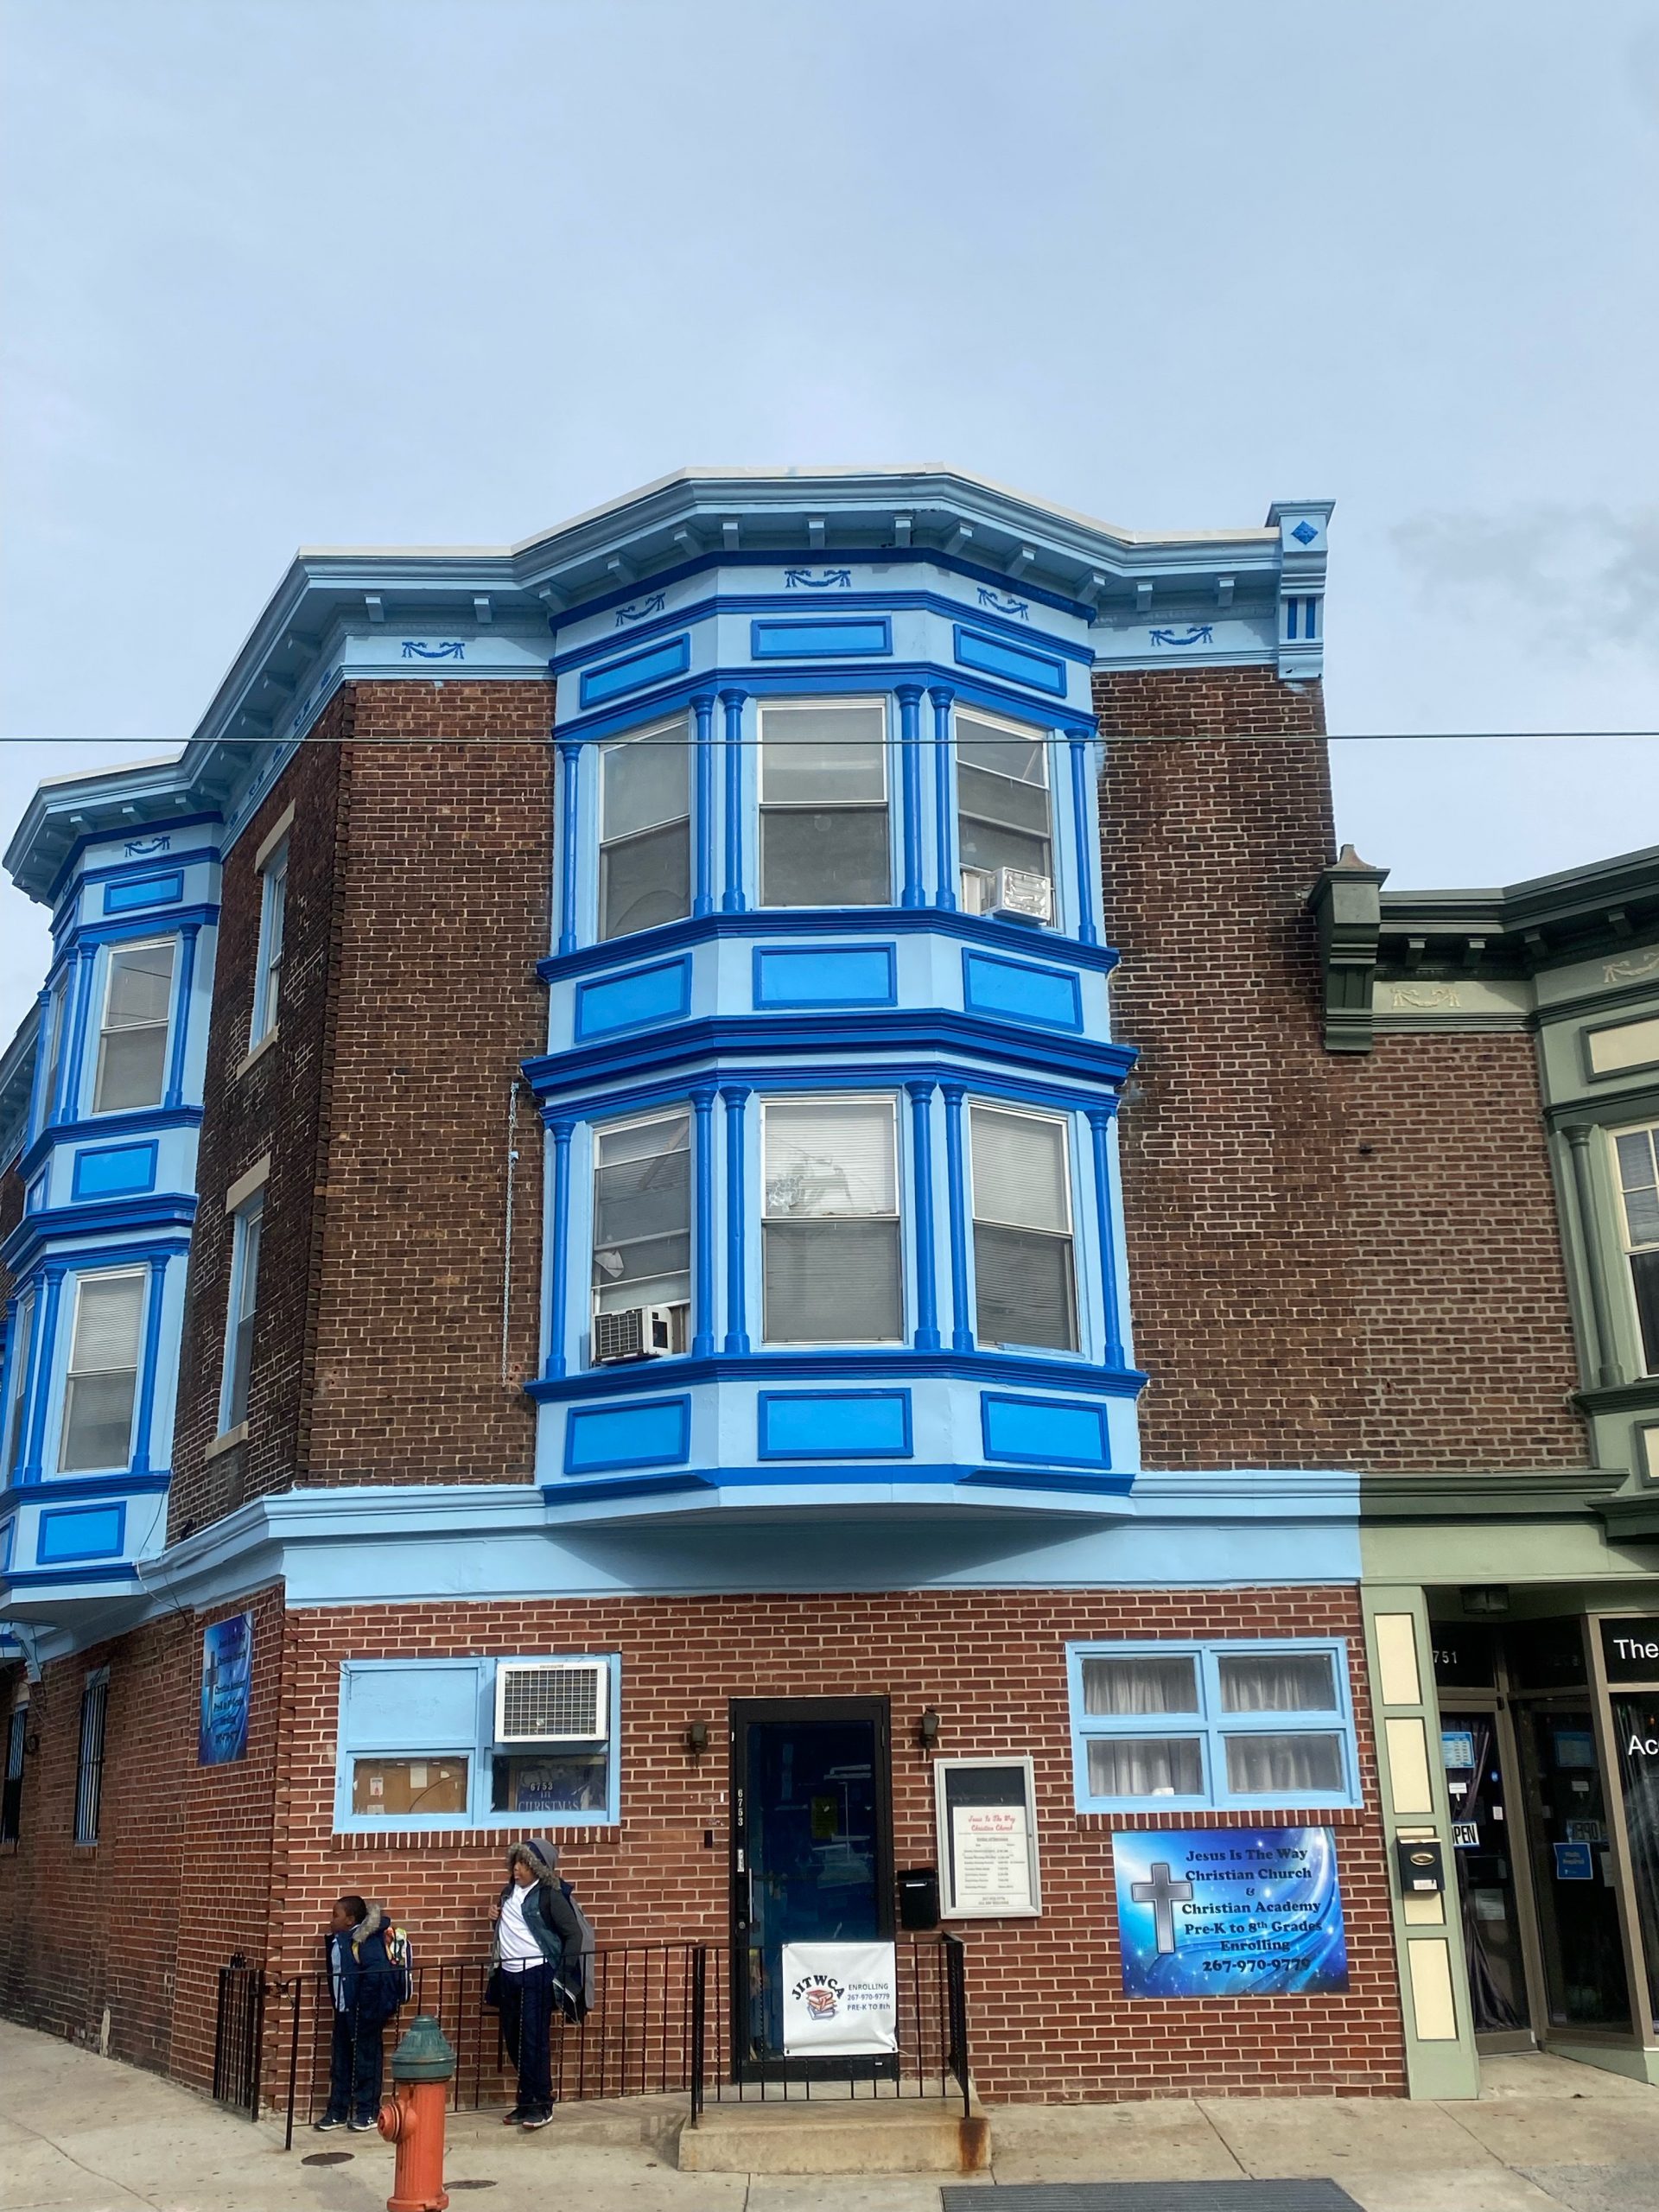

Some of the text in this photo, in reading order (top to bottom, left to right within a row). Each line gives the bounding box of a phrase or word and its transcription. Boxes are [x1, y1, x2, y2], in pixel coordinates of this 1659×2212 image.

[1613, 1639, 1659, 1660] The
[1628, 1735, 1659, 1756] Ac
[531, 1782, 553, 1791] 6753
[1452, 1824, 1477, 1845] PEN
[1185, 1848, 1307, 1861] Jesus Is The Way
[1185, 1867, 1312, 1881] Christian Church
[1246, 1887, 1255, 1896] &
[1181, 1901, 1321, 1915] Christian Academy
[1184, 1921, 1322, 1935] Pre-K to 8th Grades
[1220, 1939, 1291, 1953] Enrolling
[1202, 1958, 1311, 1973] 267-970-9779
[791, 1975, 844, 2000] JITWCA
